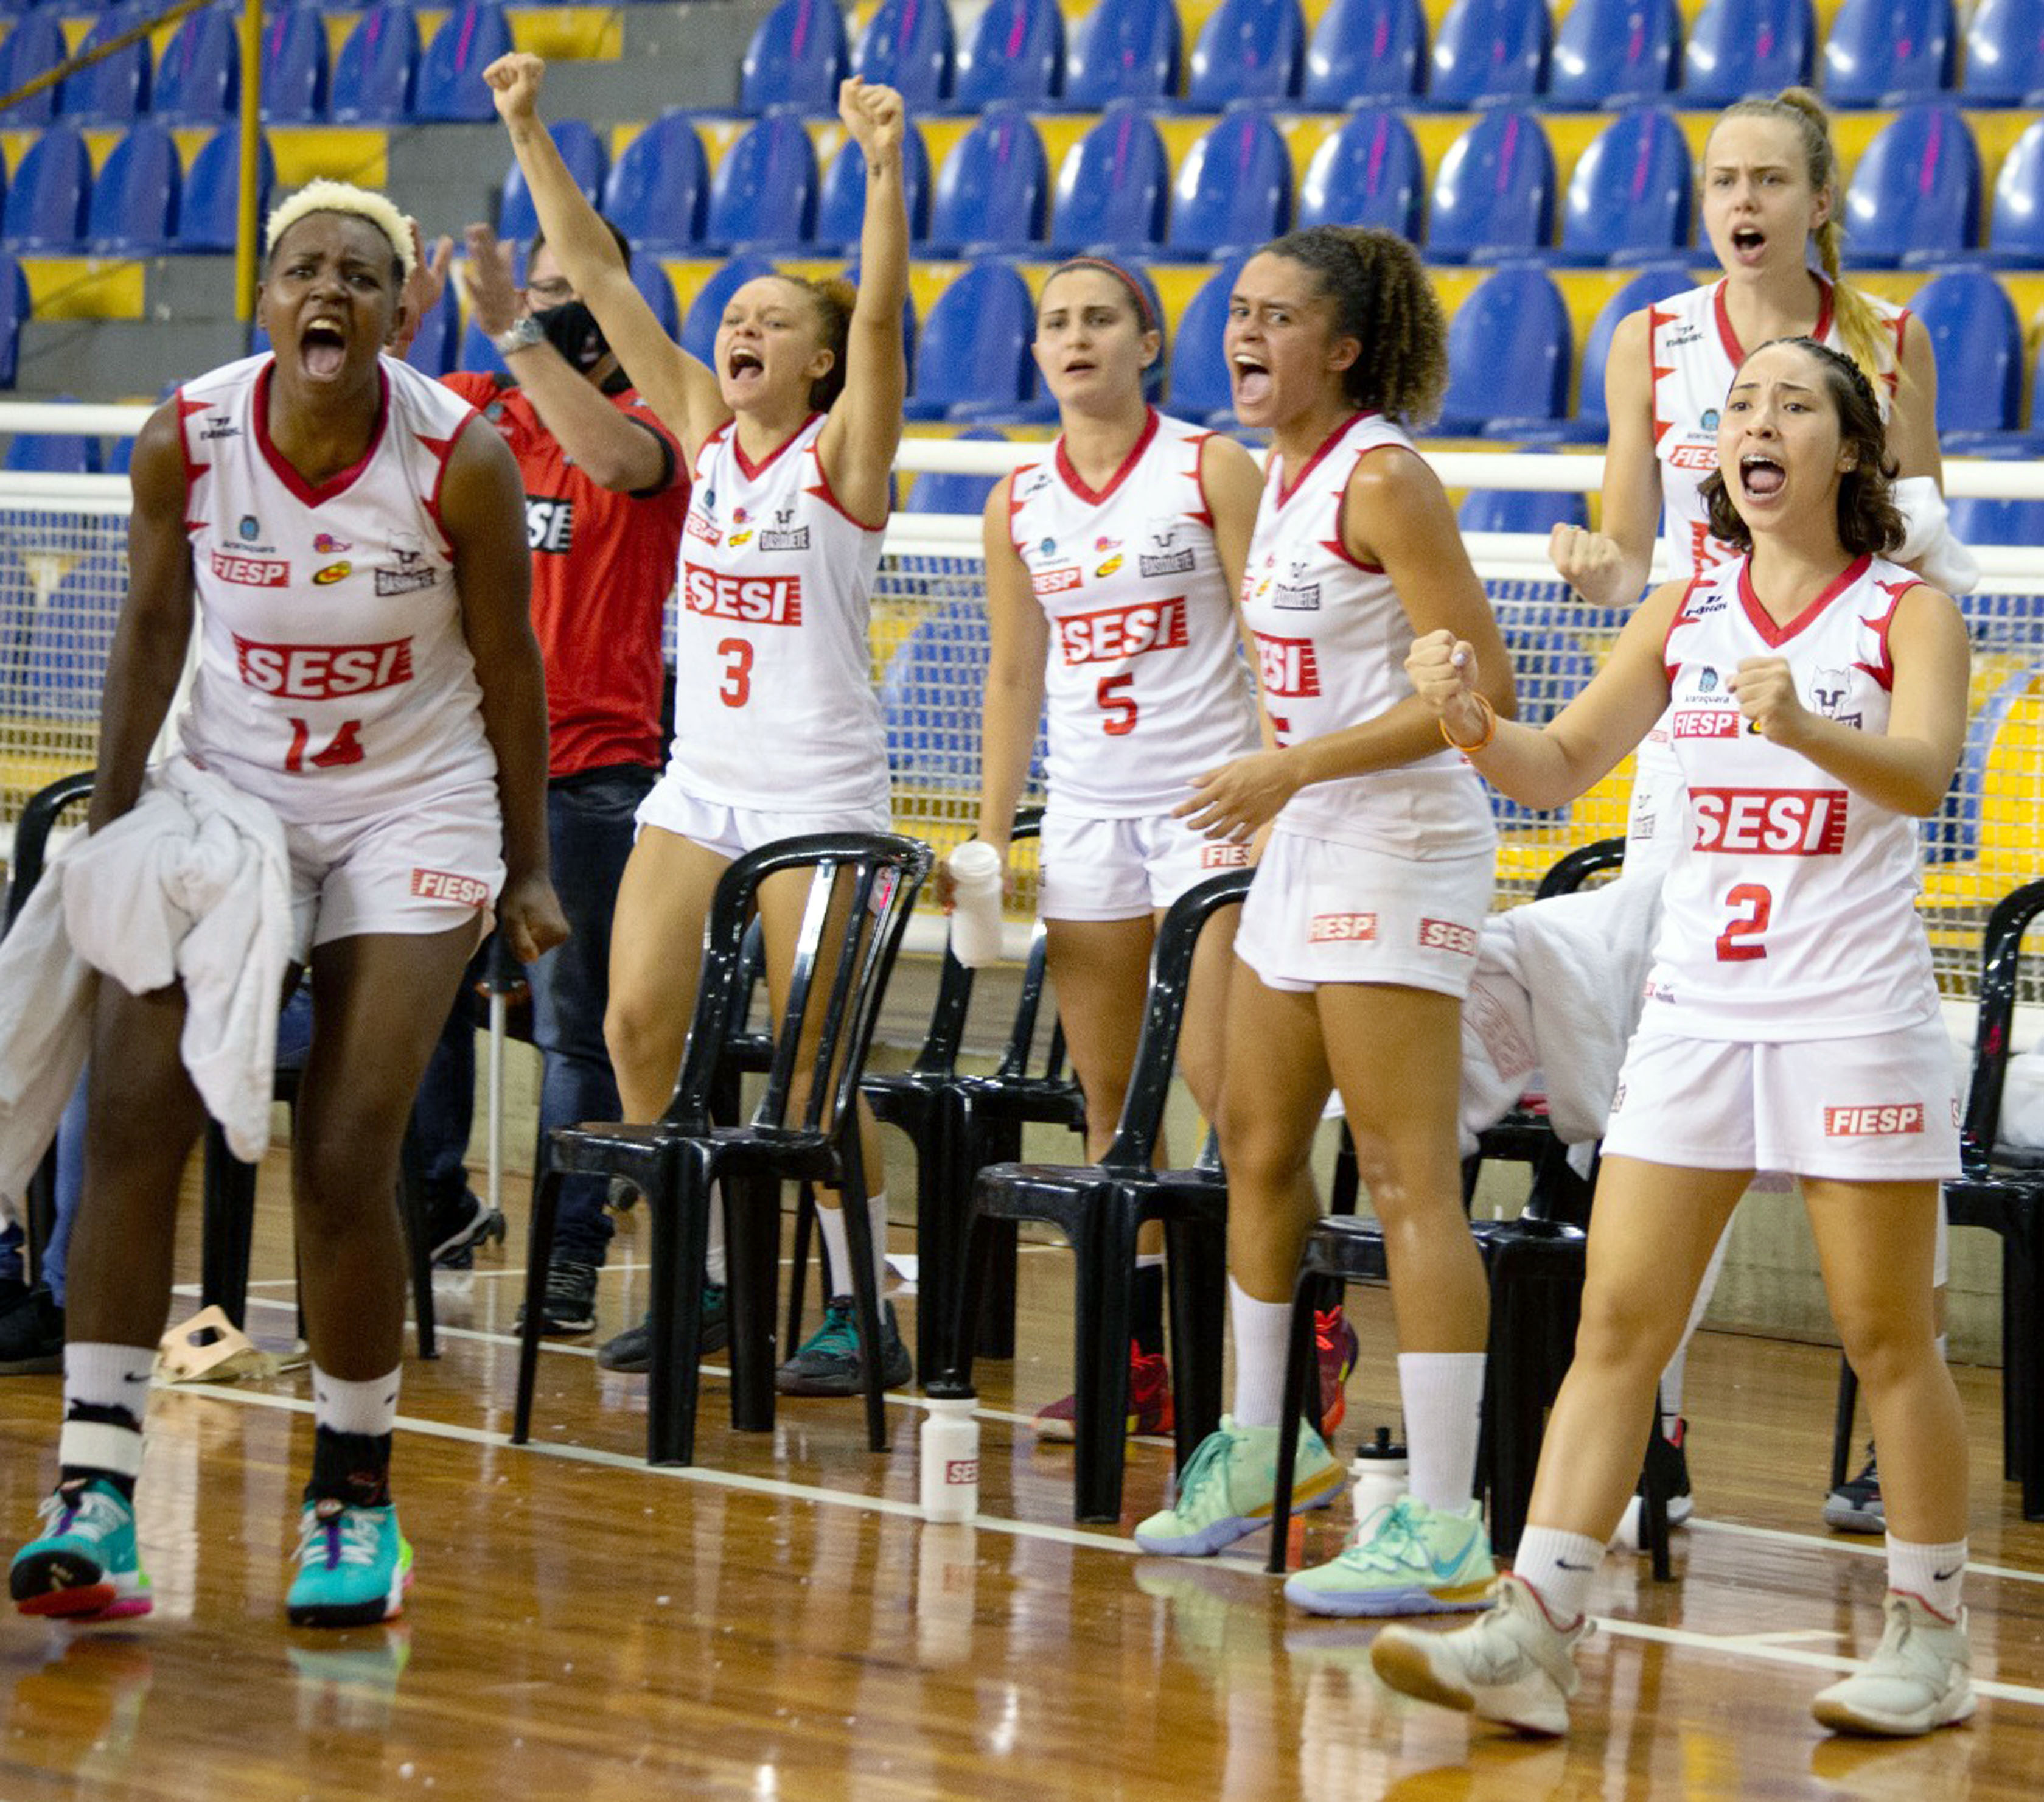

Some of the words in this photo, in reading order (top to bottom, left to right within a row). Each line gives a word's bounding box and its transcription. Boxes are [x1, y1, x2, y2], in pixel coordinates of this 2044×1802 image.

[1671, 447, 1721, 468] FIES
[214, 556, 284, 585] FIESP
[689, 570, 787, 622] SESI
[1063, 606, 1175, 662] SESI
[245, 644, 399, 697] SESI
[717, 637, 754, 708] 3
[1097, 672, 1139, 736] 5
[1675, 713, 1733, 736] FIESP
[1692, 795, 1829, 851] SESI
[1207, 846, 1249, 866] FIES
[418, 873, 487, 904] FIESP
[1716, 883, 1772, 962] 2
[1425, 923, 1475, 954] SES
[1833, 1107, 1919, 1134] FIESP
[949, 1462, 978, 1483] SE
